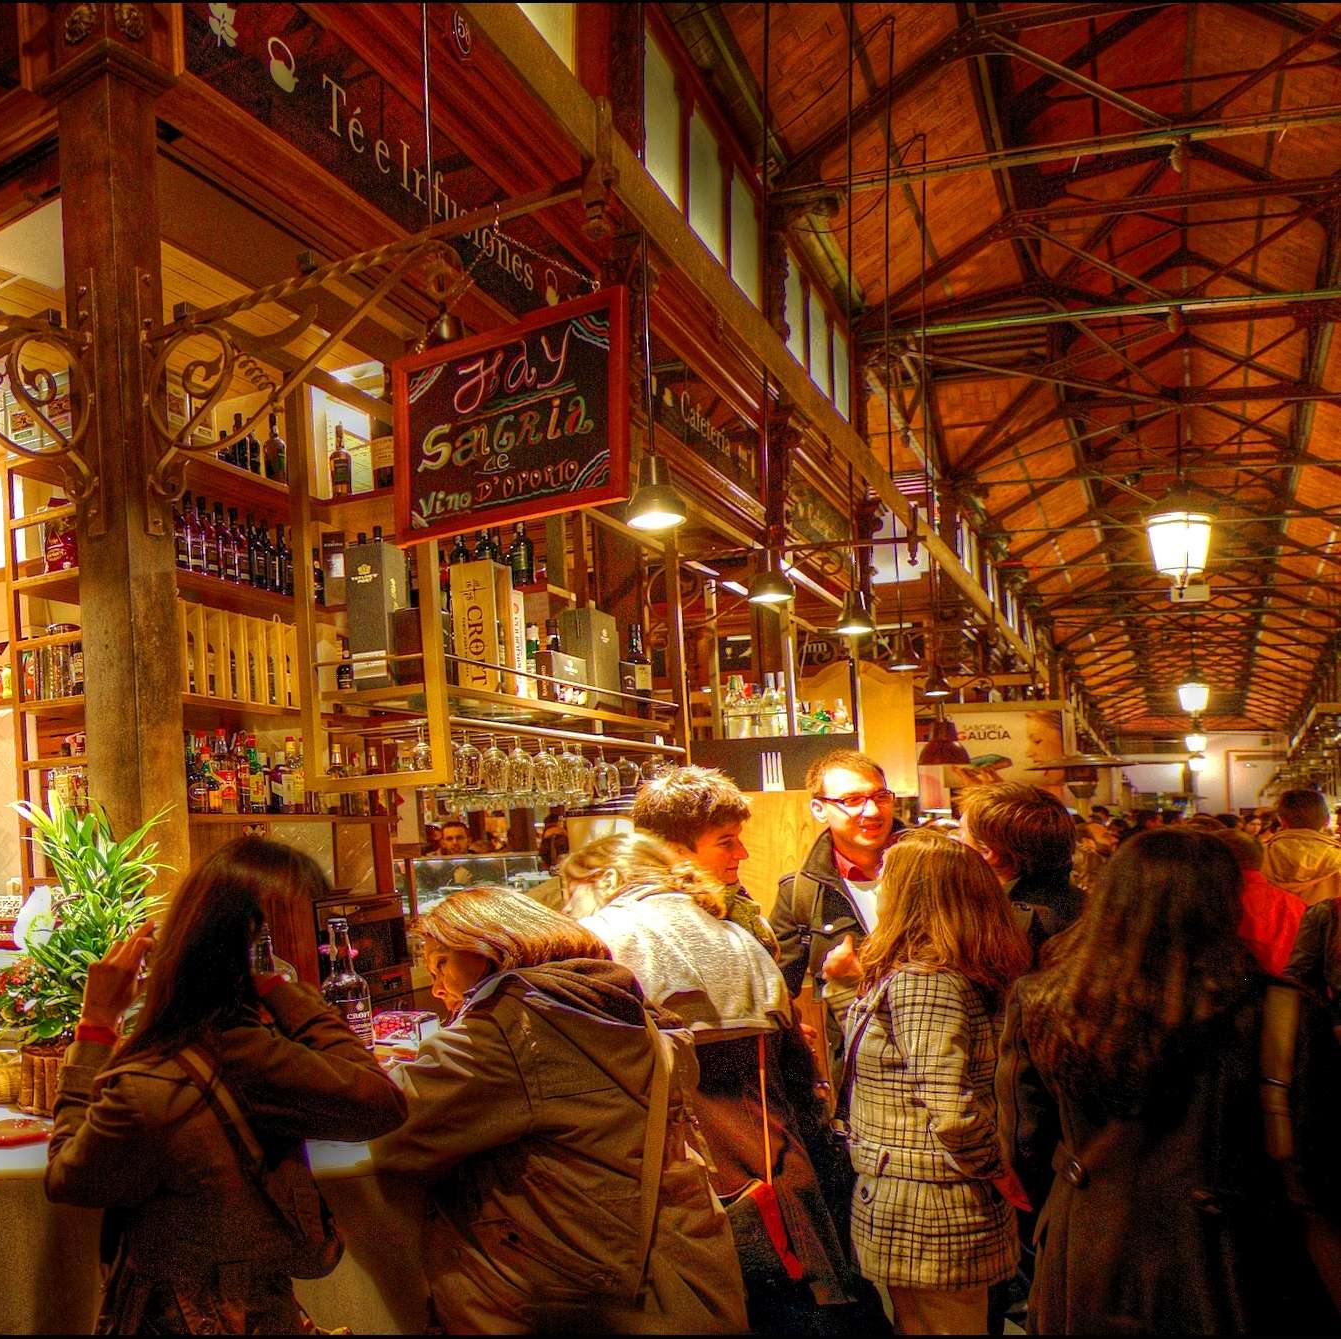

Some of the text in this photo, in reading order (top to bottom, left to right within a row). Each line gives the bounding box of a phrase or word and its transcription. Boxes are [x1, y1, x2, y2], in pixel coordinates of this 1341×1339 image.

[322, 73, 365, 154] Té
[375, 139, 391, 174] e
[419, 489, 472, 518] Vino
[957, 730, 1012, 742] GALICIA
